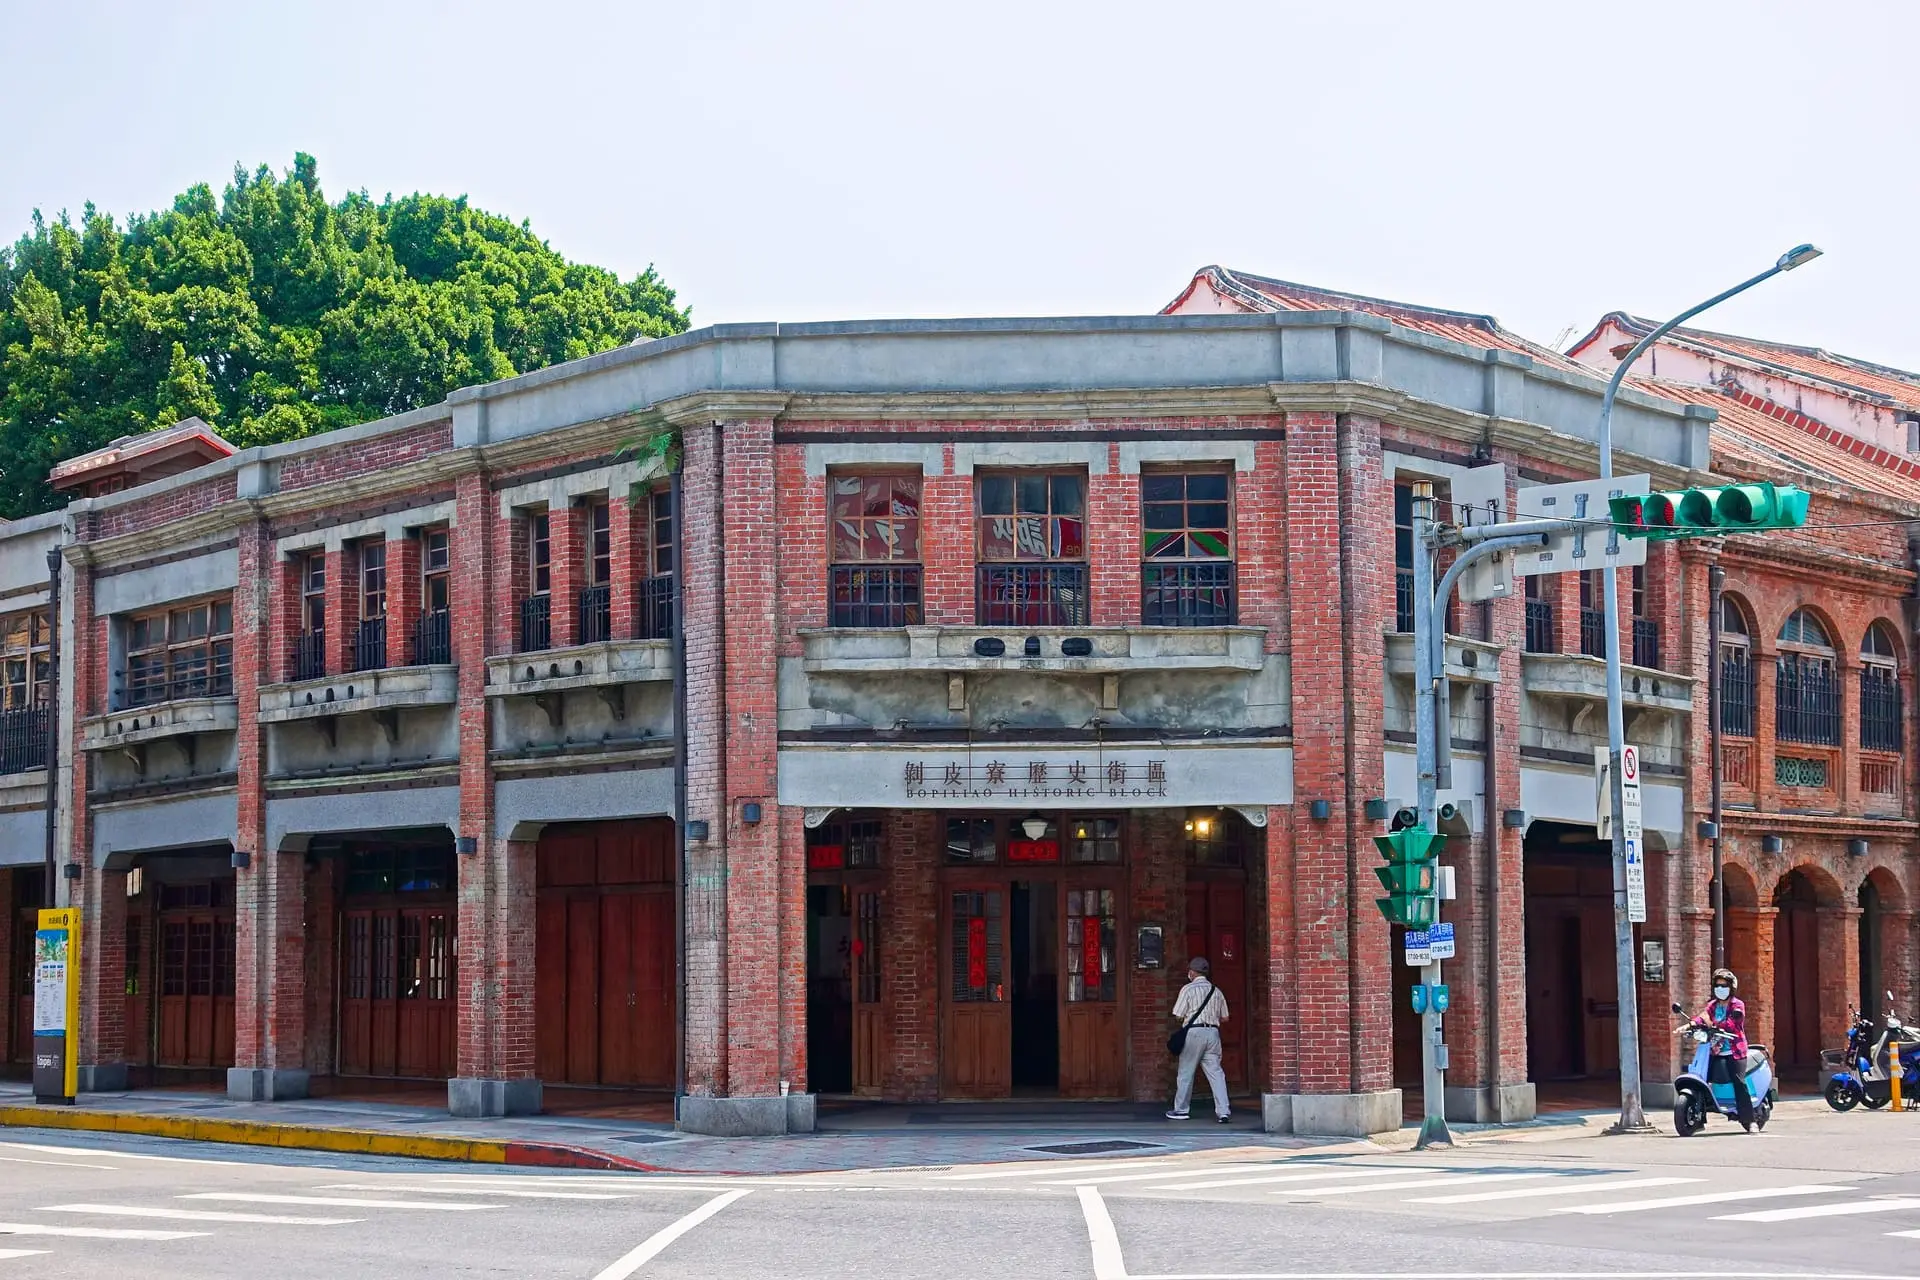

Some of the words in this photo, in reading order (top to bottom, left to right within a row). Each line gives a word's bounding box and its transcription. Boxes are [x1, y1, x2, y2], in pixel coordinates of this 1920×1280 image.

[905, 760, 1167, 786] 剝皮寮歷史街區
[906, 789, 992, 799] BOPILIAO
[1009, 788, 1096, 798] HISTORIC
[1109, 788, 1168, 797] BLOCK
